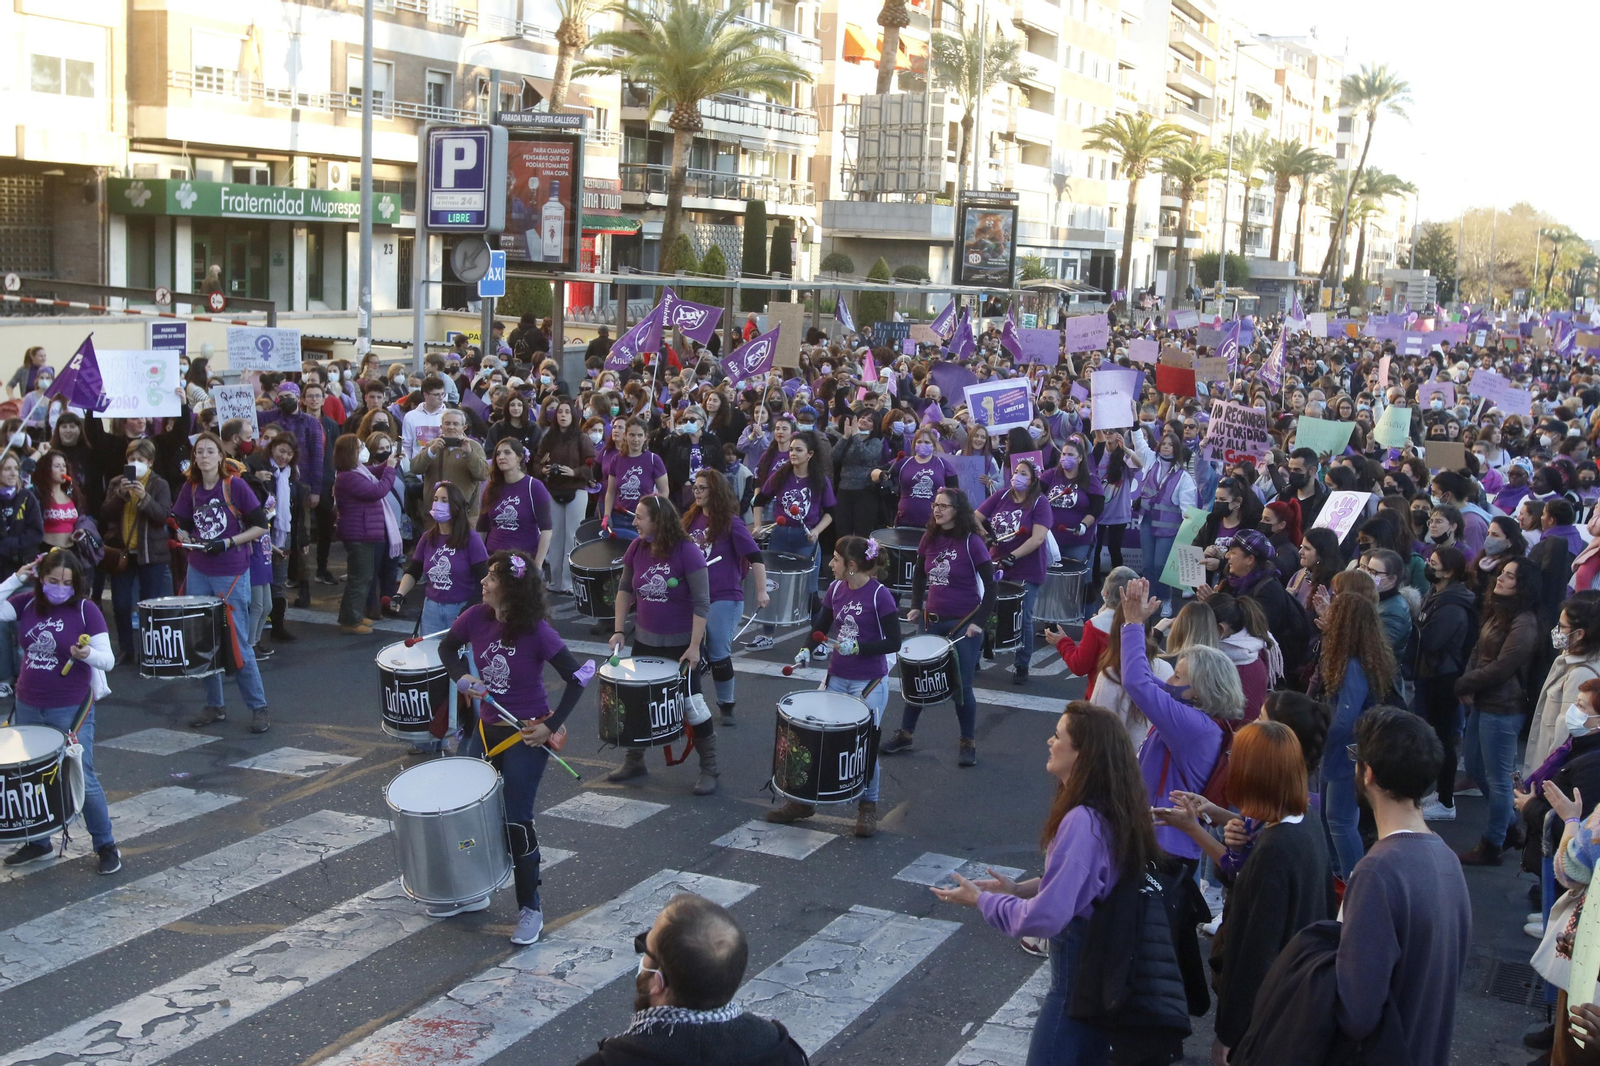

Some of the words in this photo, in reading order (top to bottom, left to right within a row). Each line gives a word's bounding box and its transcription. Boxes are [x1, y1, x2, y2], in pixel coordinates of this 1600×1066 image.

[501, 114, 521, 122] PARADA
[535, 115, 553, 123] PUERTA
[553, 116, 579, 125] GALLEGOS
[441, 138, 478, 188] P
[584, 179, 614, 190] RESTAURANTE
[221, 187, 304, 215] Fraternidad
[600, 193, 622, 210] TOWN
[448, 213, 471, 223] LIBRE
[383, 243, 393, 255] 23
[968, 253, 981, 264] RED
[1212, 403, 1223, 420] NO
[1224, 405, 1266, 429] RECONOZCO
[652, 727, 670, 737] sound
[12, 819, 36, 828] sister
